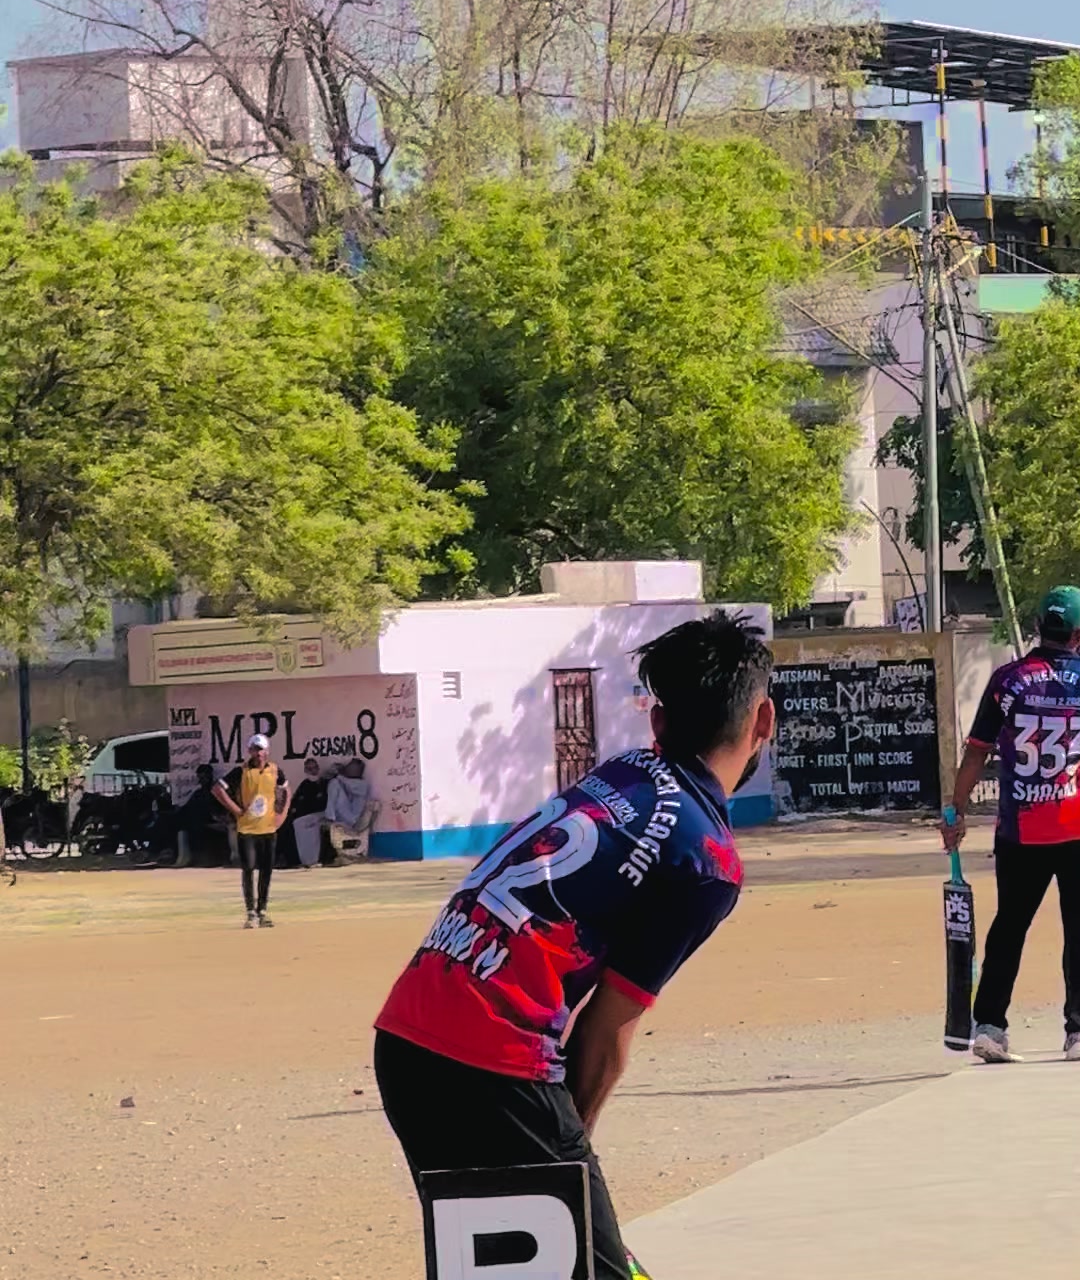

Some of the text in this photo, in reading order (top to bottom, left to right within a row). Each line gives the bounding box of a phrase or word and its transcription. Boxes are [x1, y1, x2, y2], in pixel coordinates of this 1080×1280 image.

[783, 697, 828, 711] OVERS
[311, 735, 357, 760] SEASON
[357, 709, 379, 761] 8
[878, 751, 913, 765] SCORE
[610, 749, 681, 796] REMIER
[810, 782, 846, 796] TOTAL
[618, 800, 681, 887] LEAGUE
